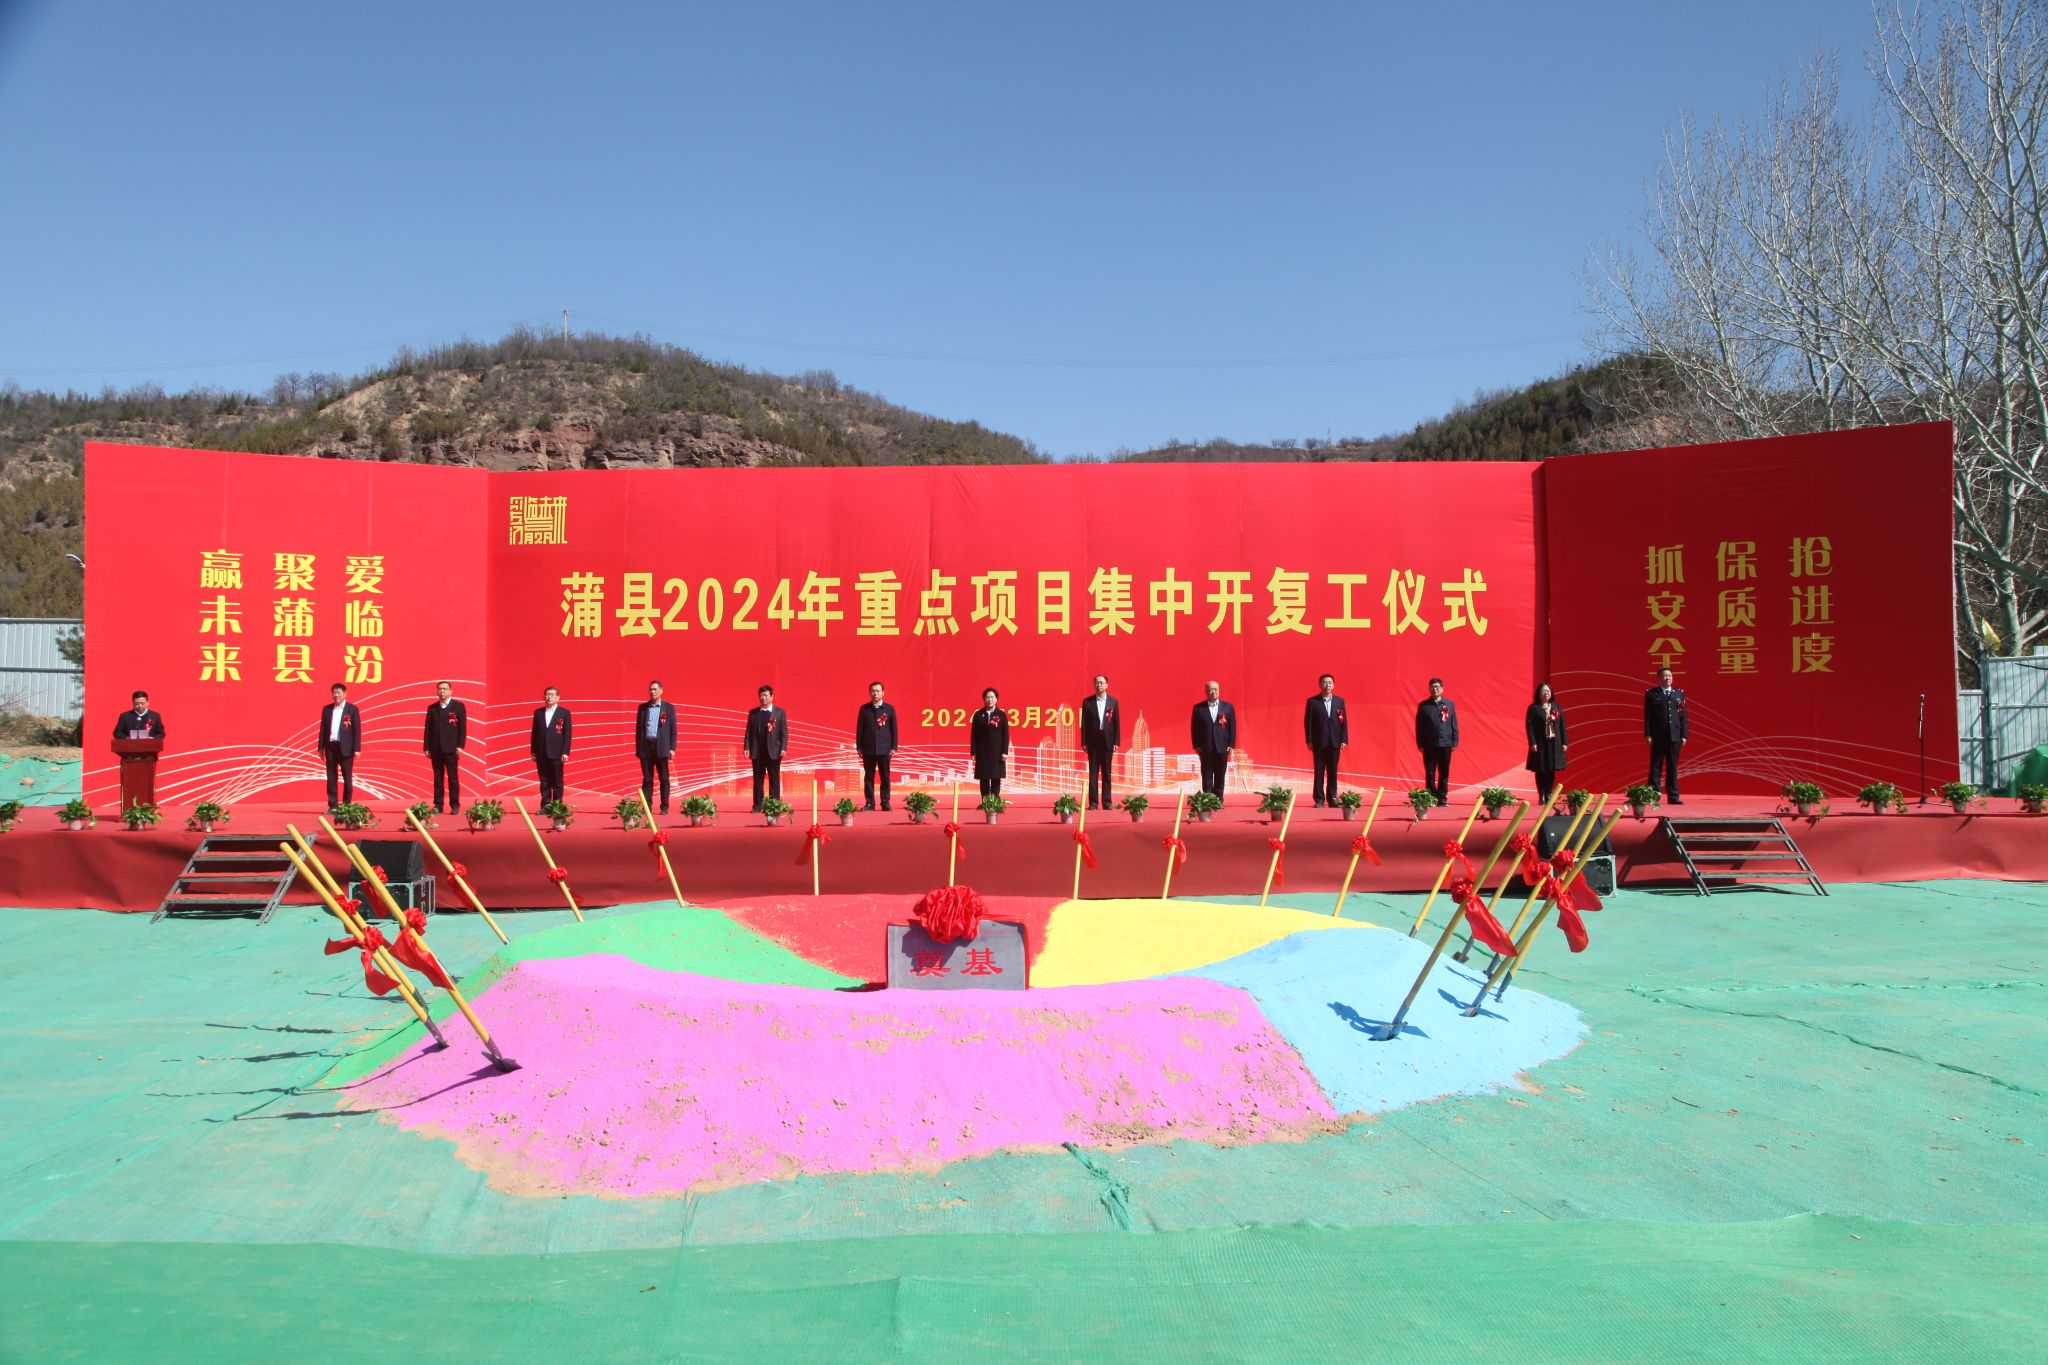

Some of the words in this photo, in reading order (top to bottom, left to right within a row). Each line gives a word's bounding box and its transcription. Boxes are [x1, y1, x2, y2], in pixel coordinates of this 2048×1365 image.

[199, 548, 244, 682] 赢未来
[272, 552, 317, 683] 聚蒲县
[344, 555, 385, 684] 爱临汾
[560, 567, 1489, 638] 蒲县2024年重点项目集中开复工仪式
[1645, 543, 1687, 675] 抓安全
[1715, 540, 1759, 674] 保质量
[1788, 536, 1835, 673] 抢进度
[921, 706, 1084, 729] 2023月20
[907, 946, 1004, 978] 奠基
